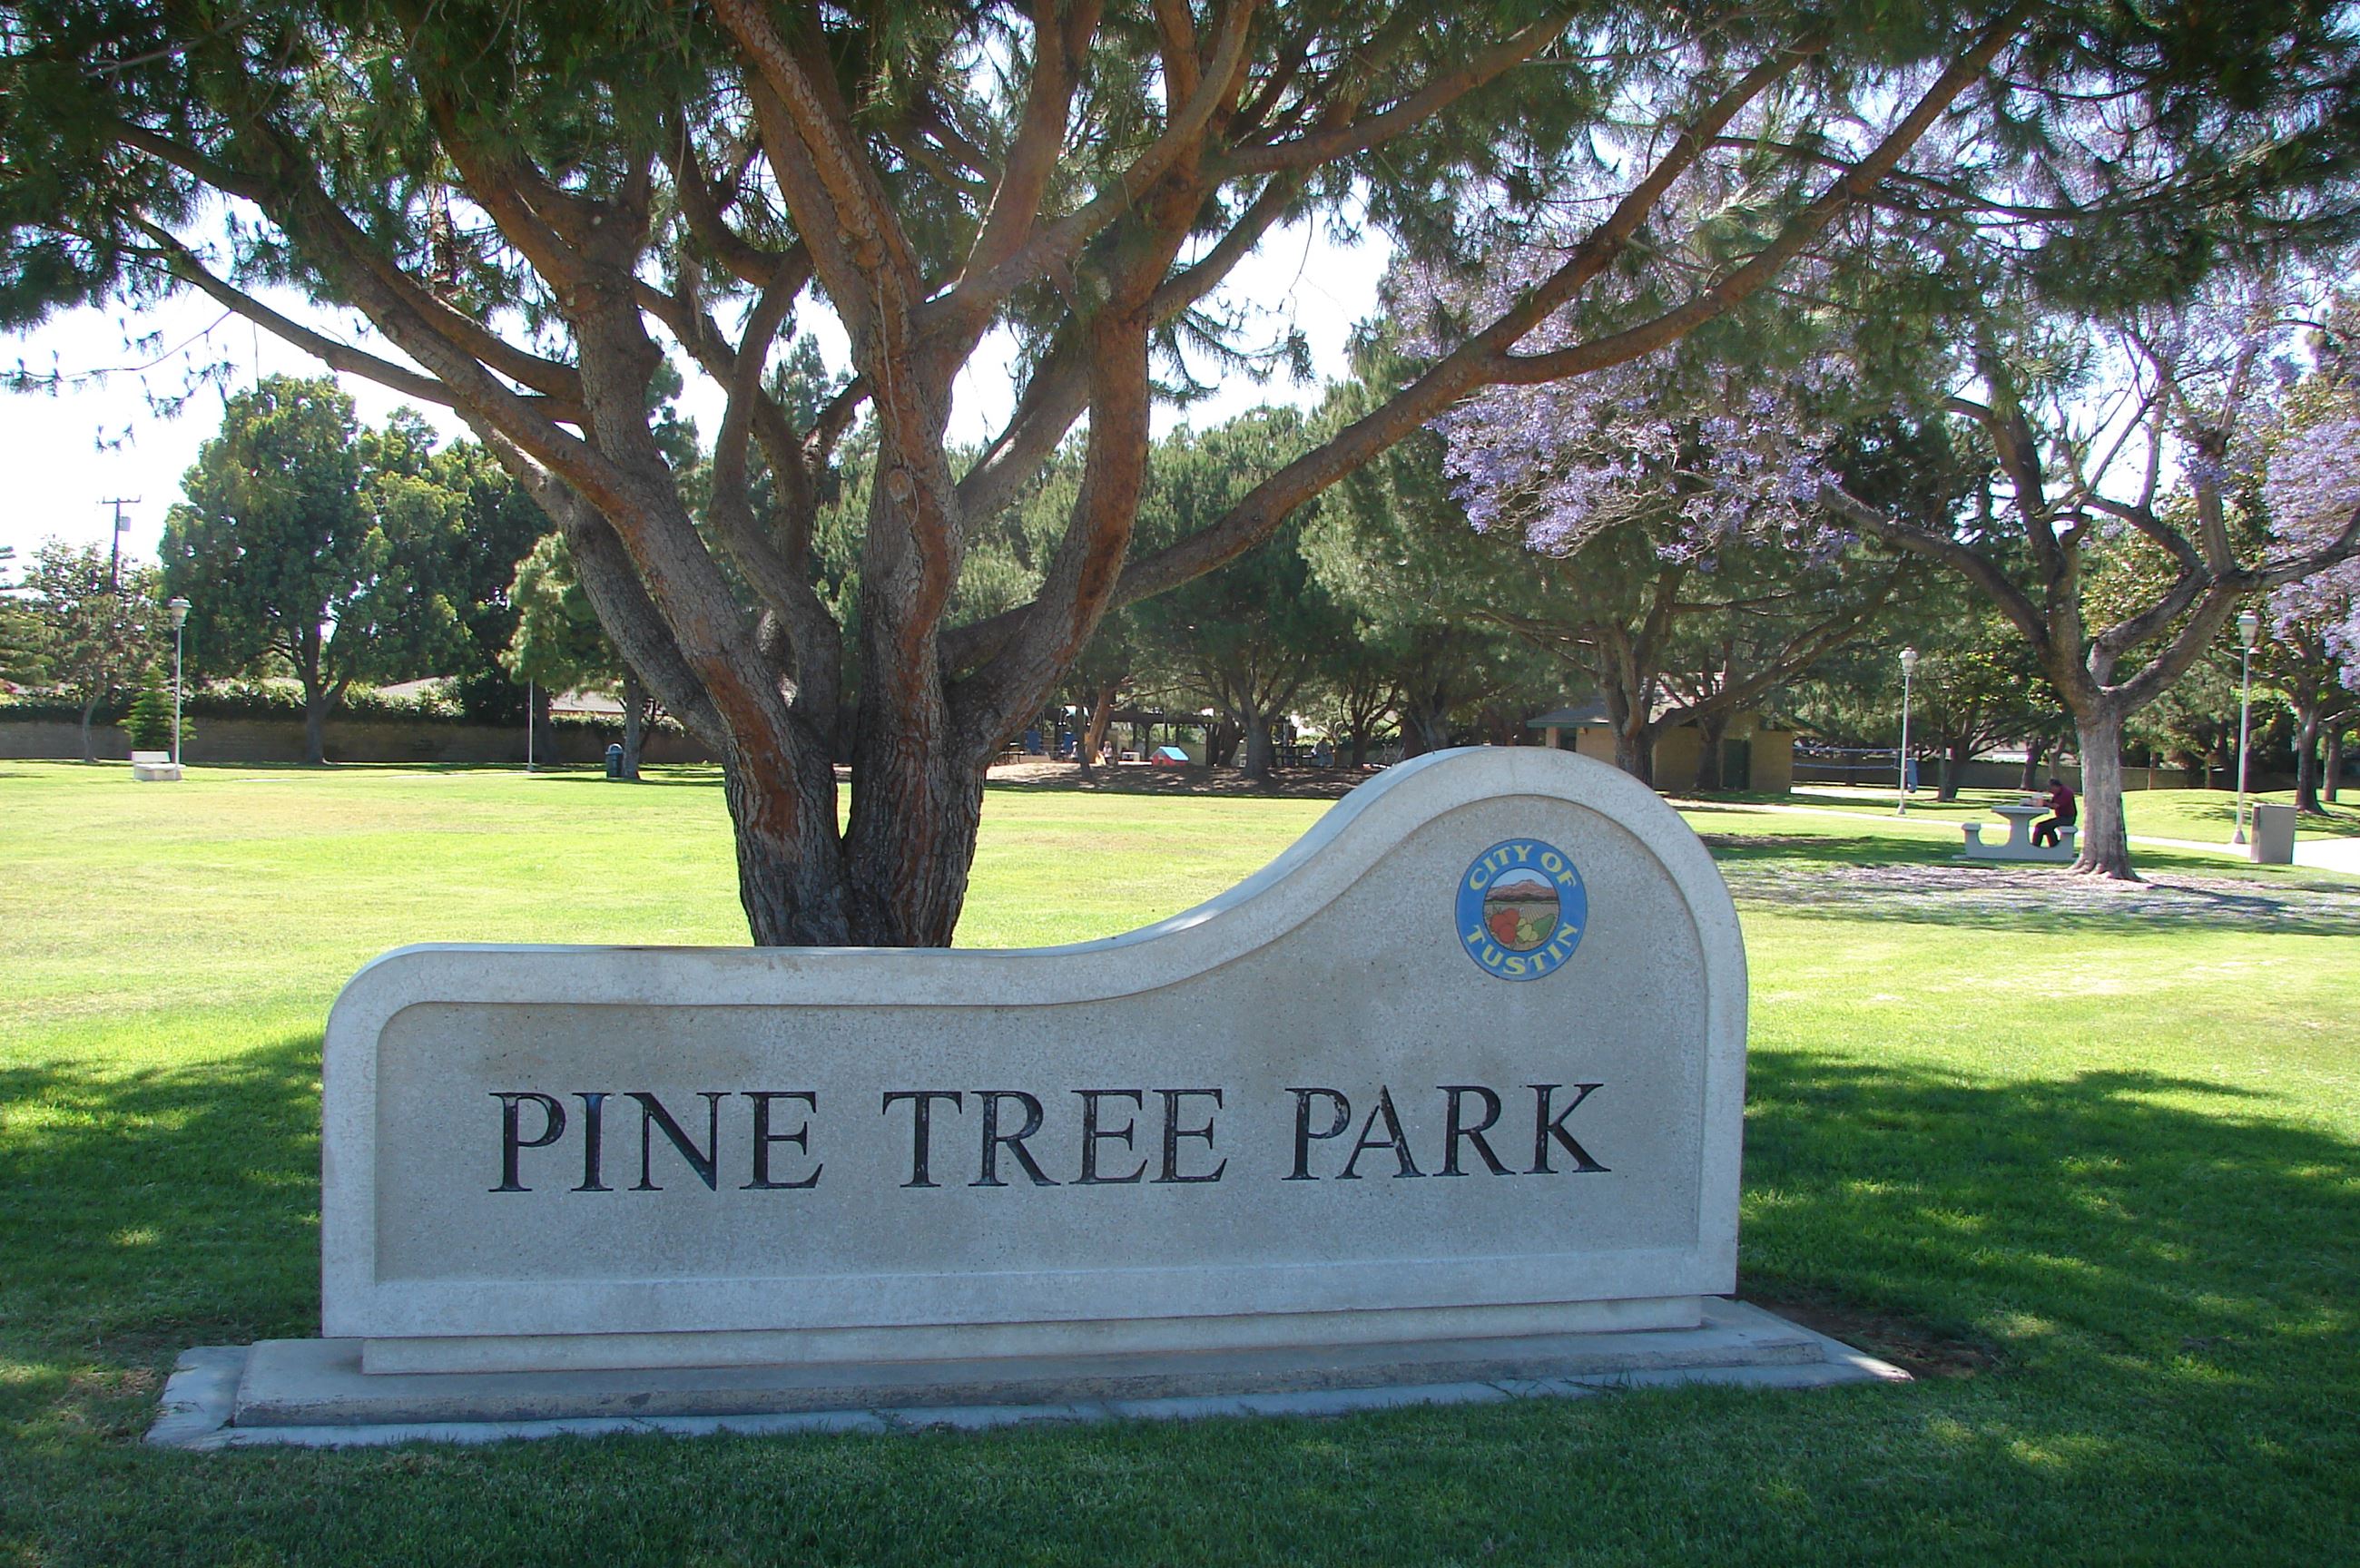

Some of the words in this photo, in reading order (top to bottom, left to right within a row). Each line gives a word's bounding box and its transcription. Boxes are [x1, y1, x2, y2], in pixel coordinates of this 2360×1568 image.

[1469, 845, 1533, 890] CITY
[1540, 851, 1577, 888] OF
[1467, 922, 1578, 975] TUSTIN
[487, 1091, 823, 1192] PINE
[882, 1088, 1228, 1188] TREE
[1281, 1083, 1612, 1181] PARK
